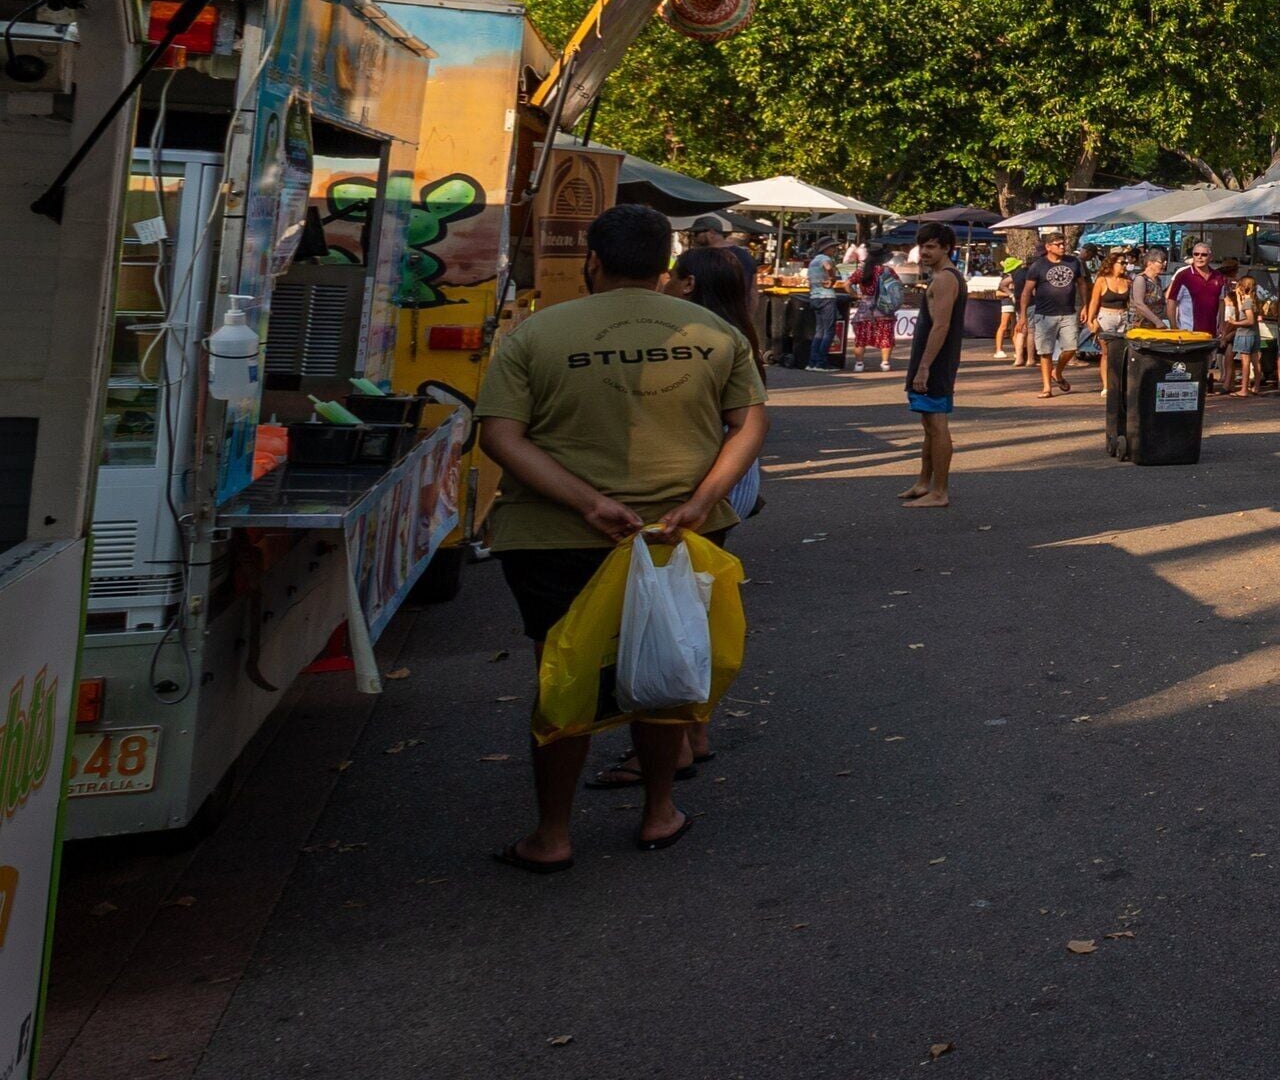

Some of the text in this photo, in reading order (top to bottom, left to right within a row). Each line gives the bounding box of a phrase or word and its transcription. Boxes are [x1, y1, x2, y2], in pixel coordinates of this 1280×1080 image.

[567, 345, 714, 369] STUSSY
[661, 373, 691, 394] LONDON
[0, 662, 58, 819] hts
[69, 735, 149, 779] 48
